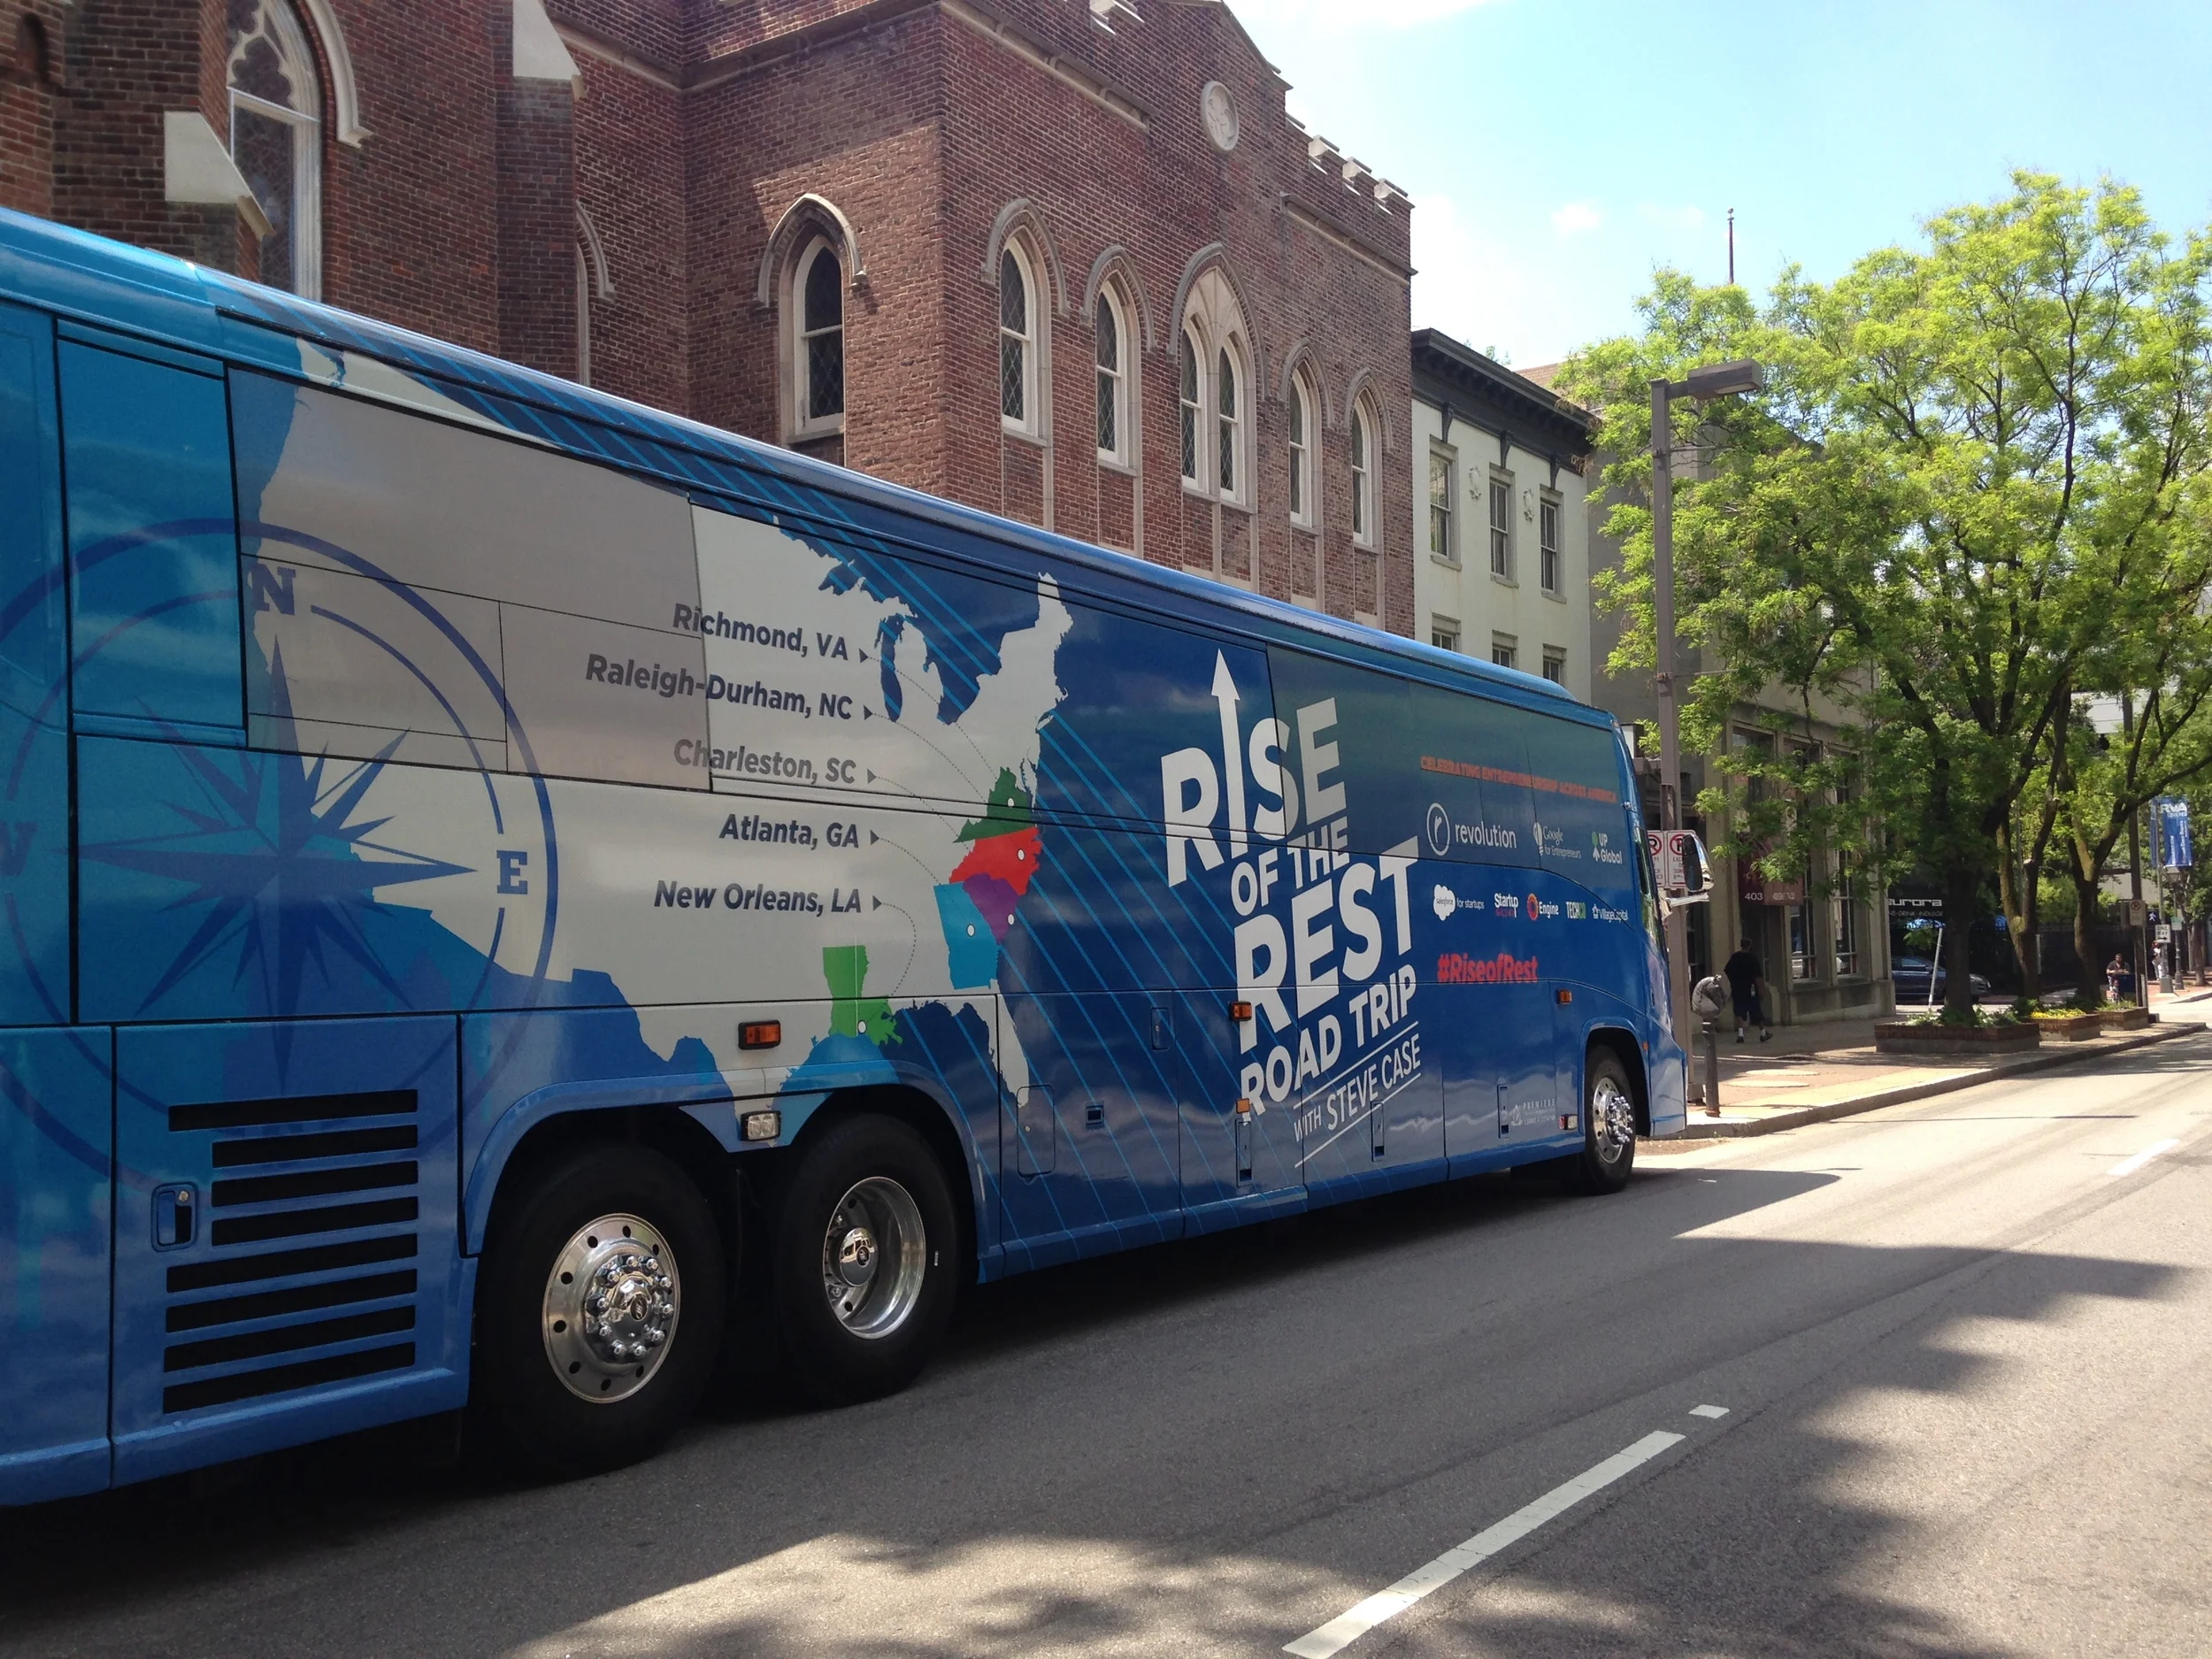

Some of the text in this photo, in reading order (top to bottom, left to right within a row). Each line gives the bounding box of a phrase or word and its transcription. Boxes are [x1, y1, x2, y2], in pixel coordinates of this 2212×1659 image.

[249, 563, 296, 615] N
[672, 603, 849, 661] Richmond, VA
[585, 653, 853, 720] Raleigh-Durham, NC
[673, 739, 857, 786] Charleston, SC
[1161, 649, 1348, 887] RISE
[719, 813, 859, 850] Atlanta, GA
[1455, 820, 1517, 849] revolution
[1543, 826, 1563, 847] Google
[1598, 833, 1609, 847] UP
[496, 849, 528, 895] E
[1232, 816, 1350, 917] OF THE
[1600, 849, 1623, 864] Global
[654, 879, 862, 918] New Orleans, LA
[1494, 893, 1519, 918] Startup
[1539, 902, 1559, 918] Engine
[1744, 892, 1763, 901] 403
[1233, 835, 1419, 1055] REST
[1437, 952, 1540, 984] #RiseofRest
[1240, 964, 1417, 1125] ROAD TRIP
[1293, 1033, 1421, 1142] WITH STEVE CASE
